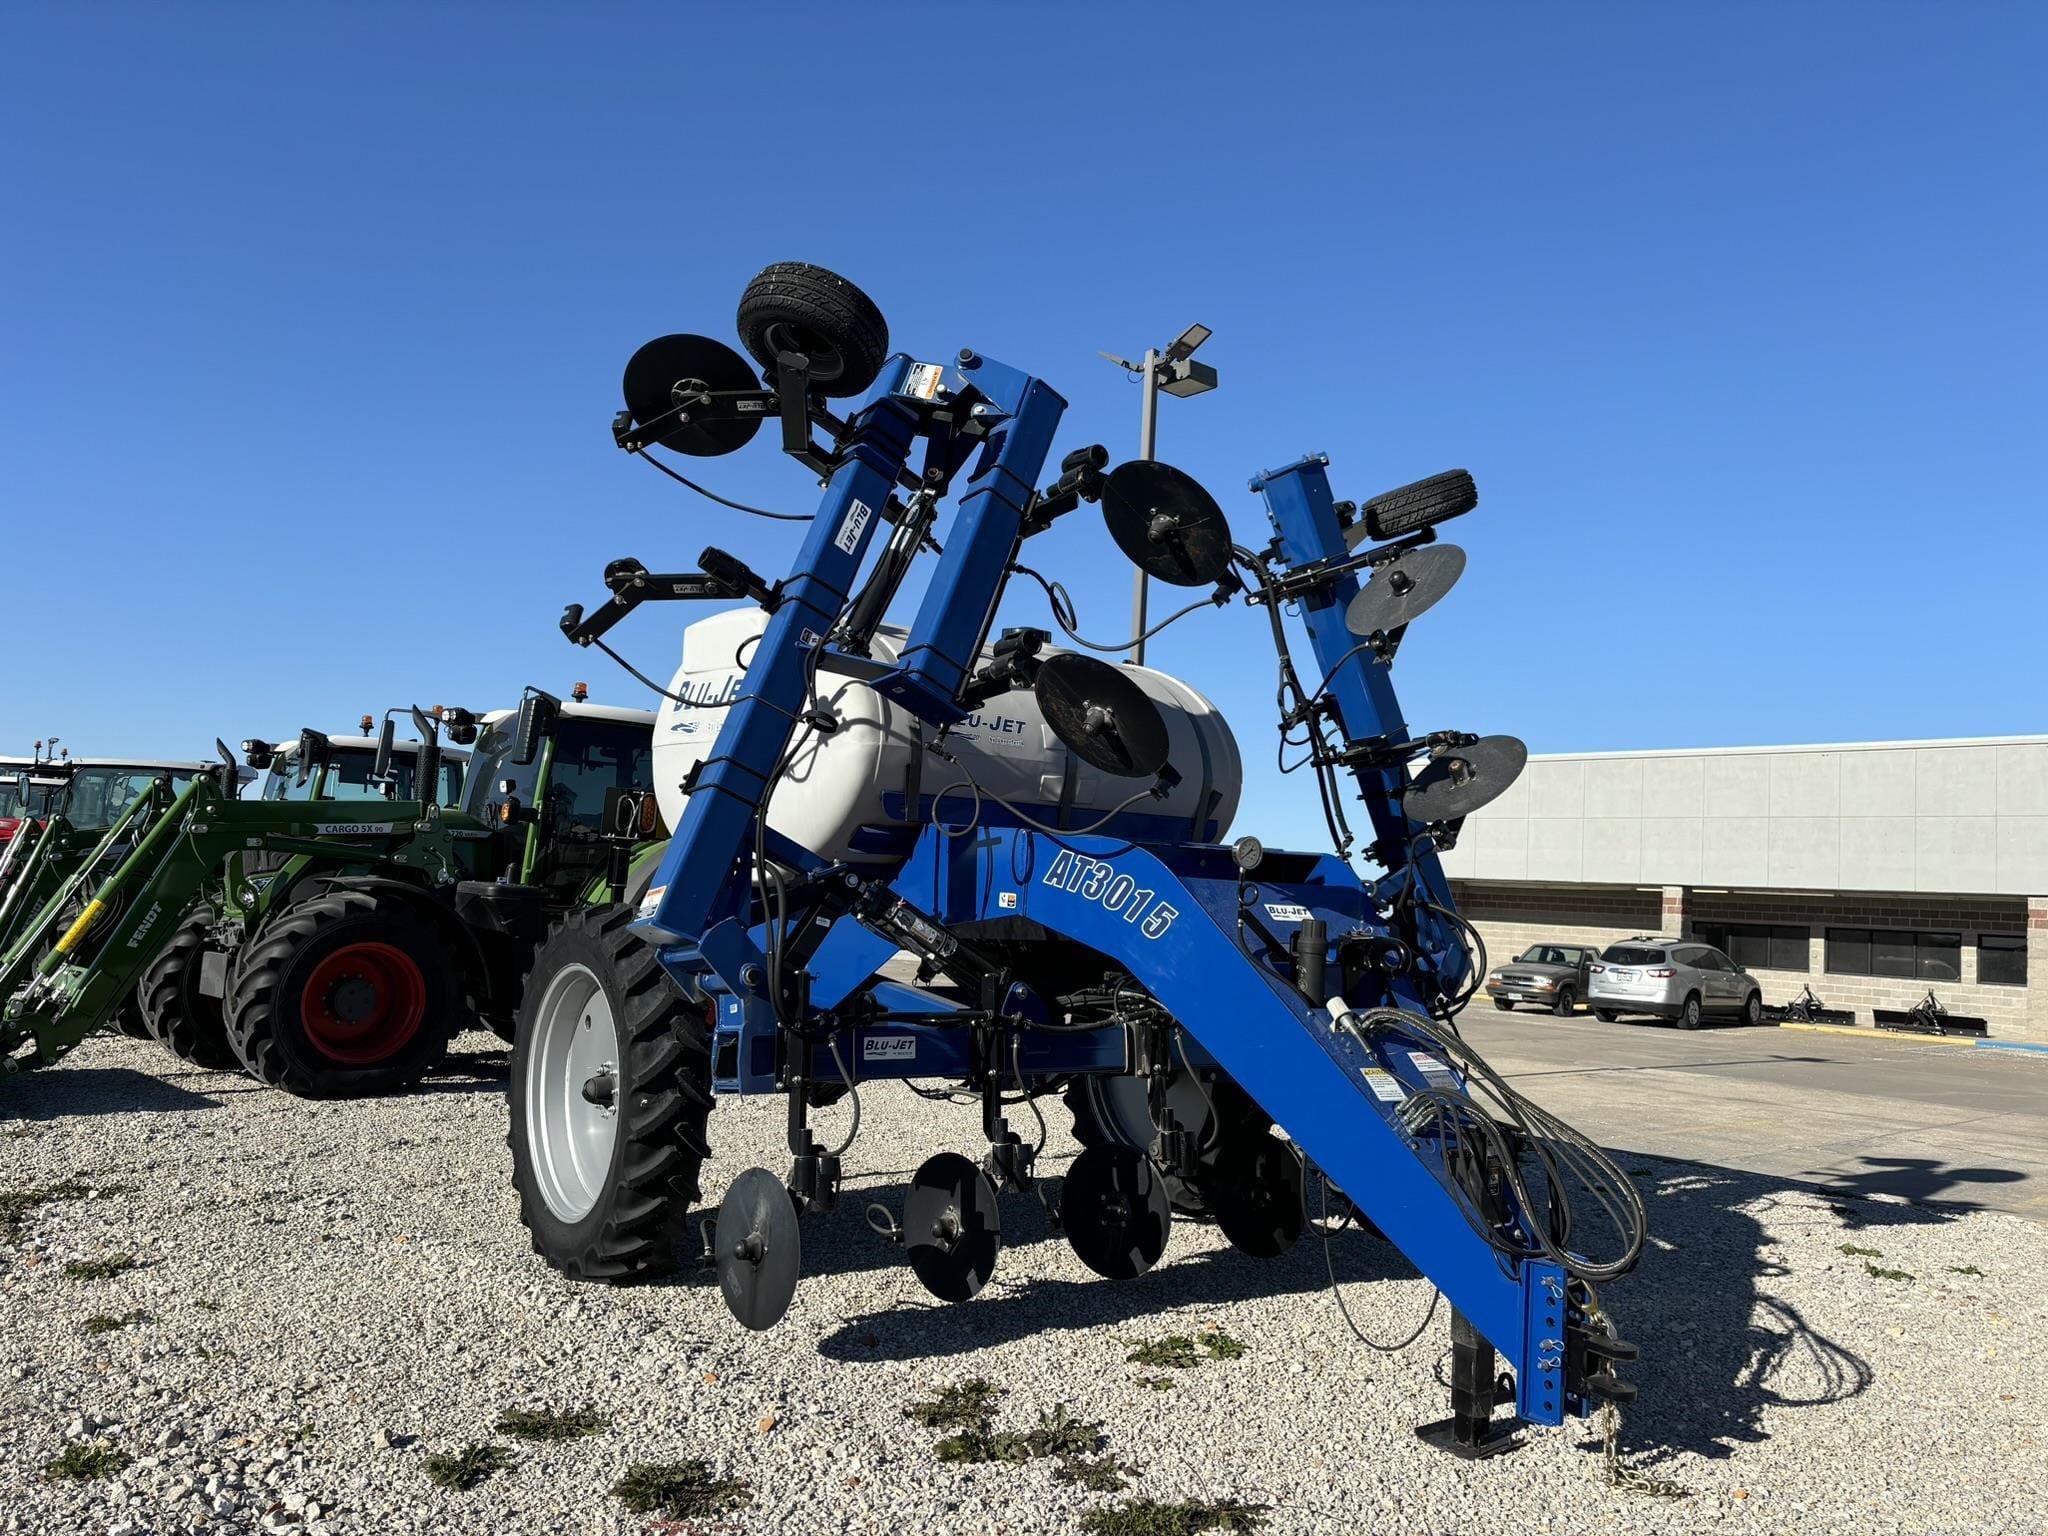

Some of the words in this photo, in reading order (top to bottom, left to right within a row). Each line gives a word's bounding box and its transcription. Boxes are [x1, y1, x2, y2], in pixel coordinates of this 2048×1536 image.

[844, 504, 869, 552] BLU-JET
[673, 674, 745, 712] BLU-JE
[959, 713, 1026, 734] U-JET
[325, 825, 359, 833] CARGO
[361, 825, 373, 833] 5X
[1043, 849, 1179, 939] AT3015
[126, 900, 162, 948] FENDT
[1268, 906, 1308, 915] BLU-JET
[865, 1040, 915, 1050] BLU-JET
